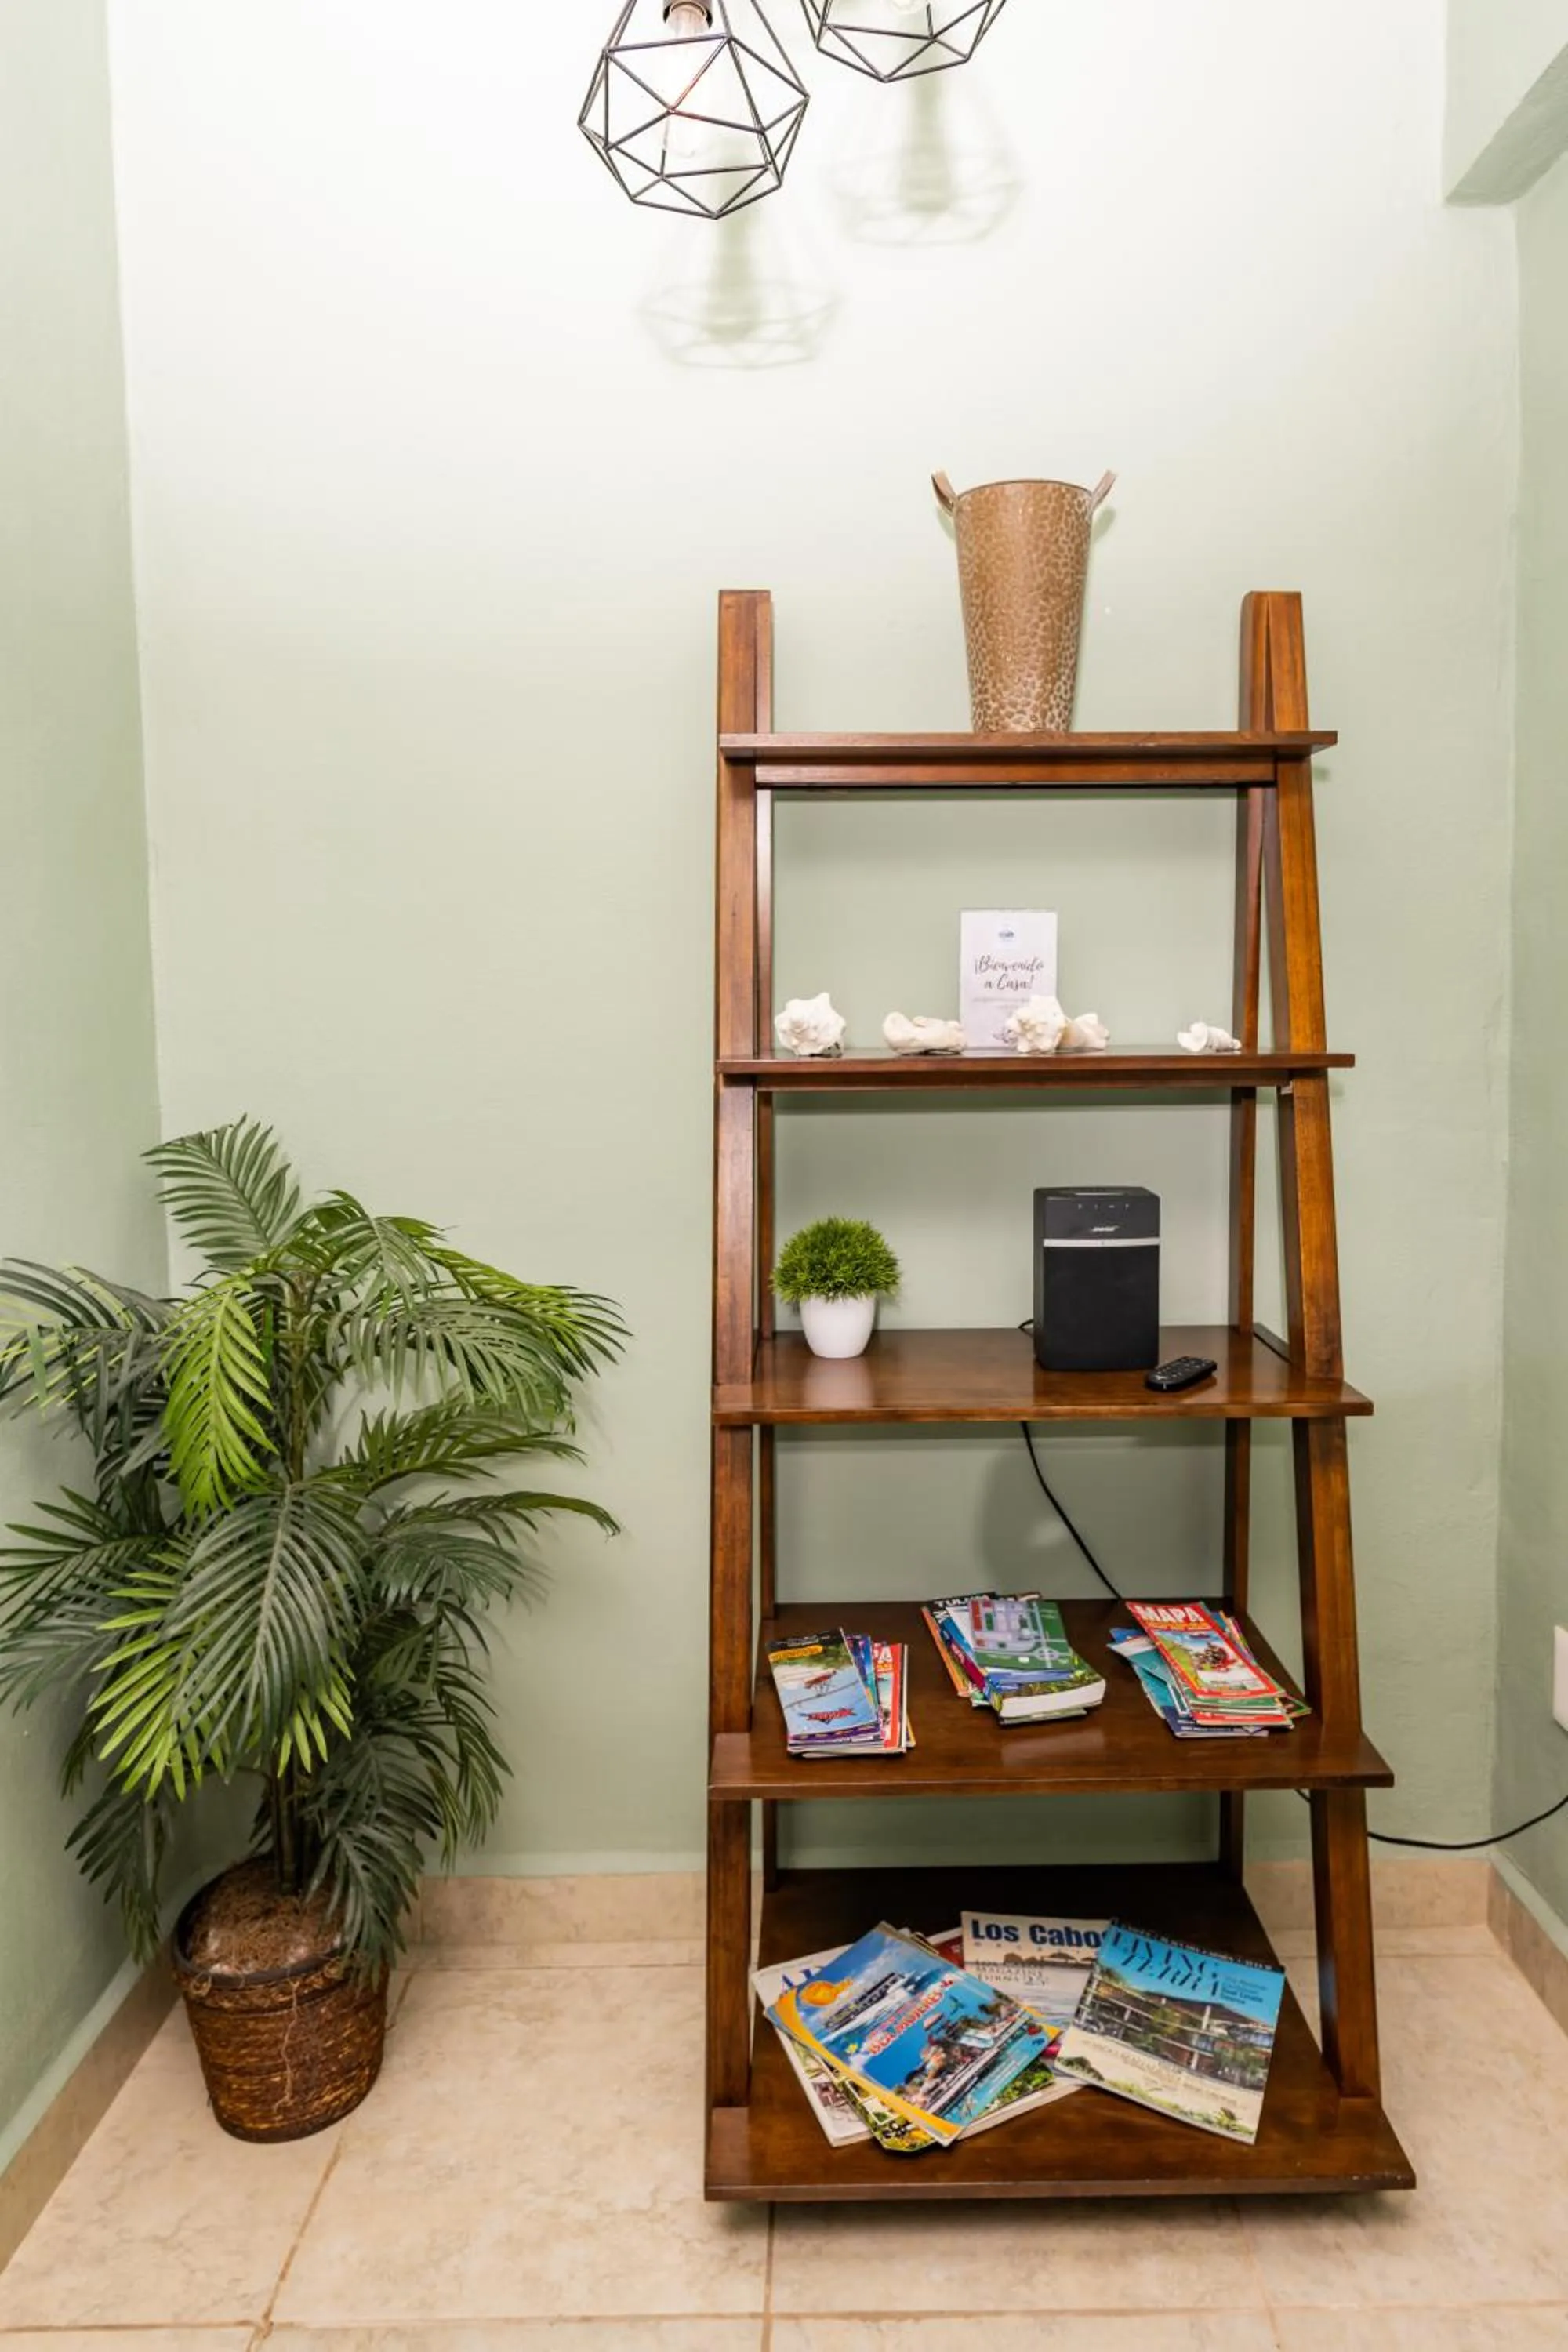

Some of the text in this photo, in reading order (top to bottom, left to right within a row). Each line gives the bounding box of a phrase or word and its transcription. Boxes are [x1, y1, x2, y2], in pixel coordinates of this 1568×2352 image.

[997, 974, 1033, 991] Casa!
[1134, 1605, 1205, 1623] MAPA
[971, 1919, 1019, 1942] Los
